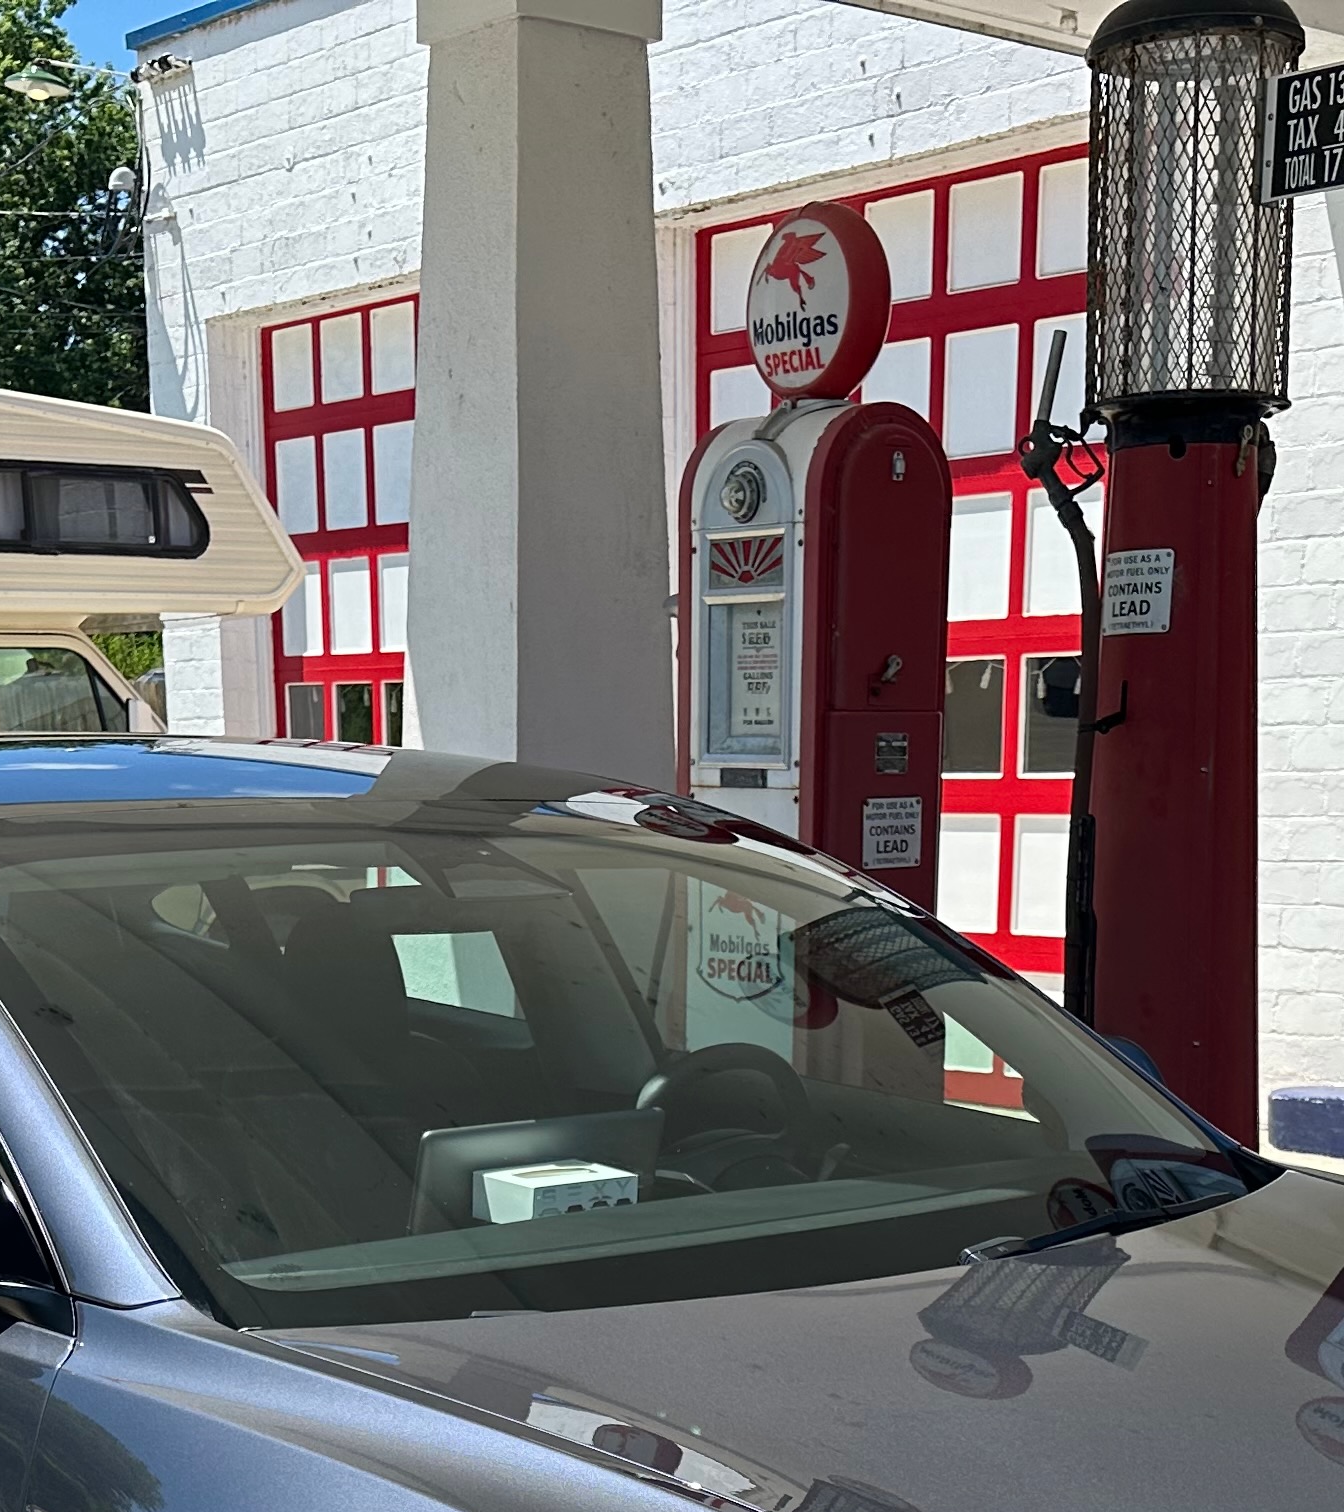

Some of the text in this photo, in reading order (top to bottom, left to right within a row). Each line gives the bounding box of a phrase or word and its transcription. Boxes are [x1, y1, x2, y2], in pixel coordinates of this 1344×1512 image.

[1289, 75, 1322, 113] GAS
[1287, 114, 1319, 151] TAX
[1333, 109, 1344, 142] 4
[1285, 153, 1316, 190] TOTAL
[1324, 148, 1343, 182] 17
[753, 311, 838, 347] Mobilgas
[765, 347, 825, 378] SPECIAL
[1124, 556, 1138, 564] USE
[1140, 554, 1152, 563] AS
[1154, 554, 1161, 562] A
[1126, 567, 1144, 577] FUEL
[1148, 566, 1170, 575] ONLY
[1108, 581, 1162, 597] CONTAINS
[1112, 600, 1151, 618] LEAD
[869, 824, 916, 836] CONTAINS
[876, 839, 909, 854] LEAD
[709, 933, 770, 960] Mobilgas
[707, 957, 773, 984] SPECIAL
